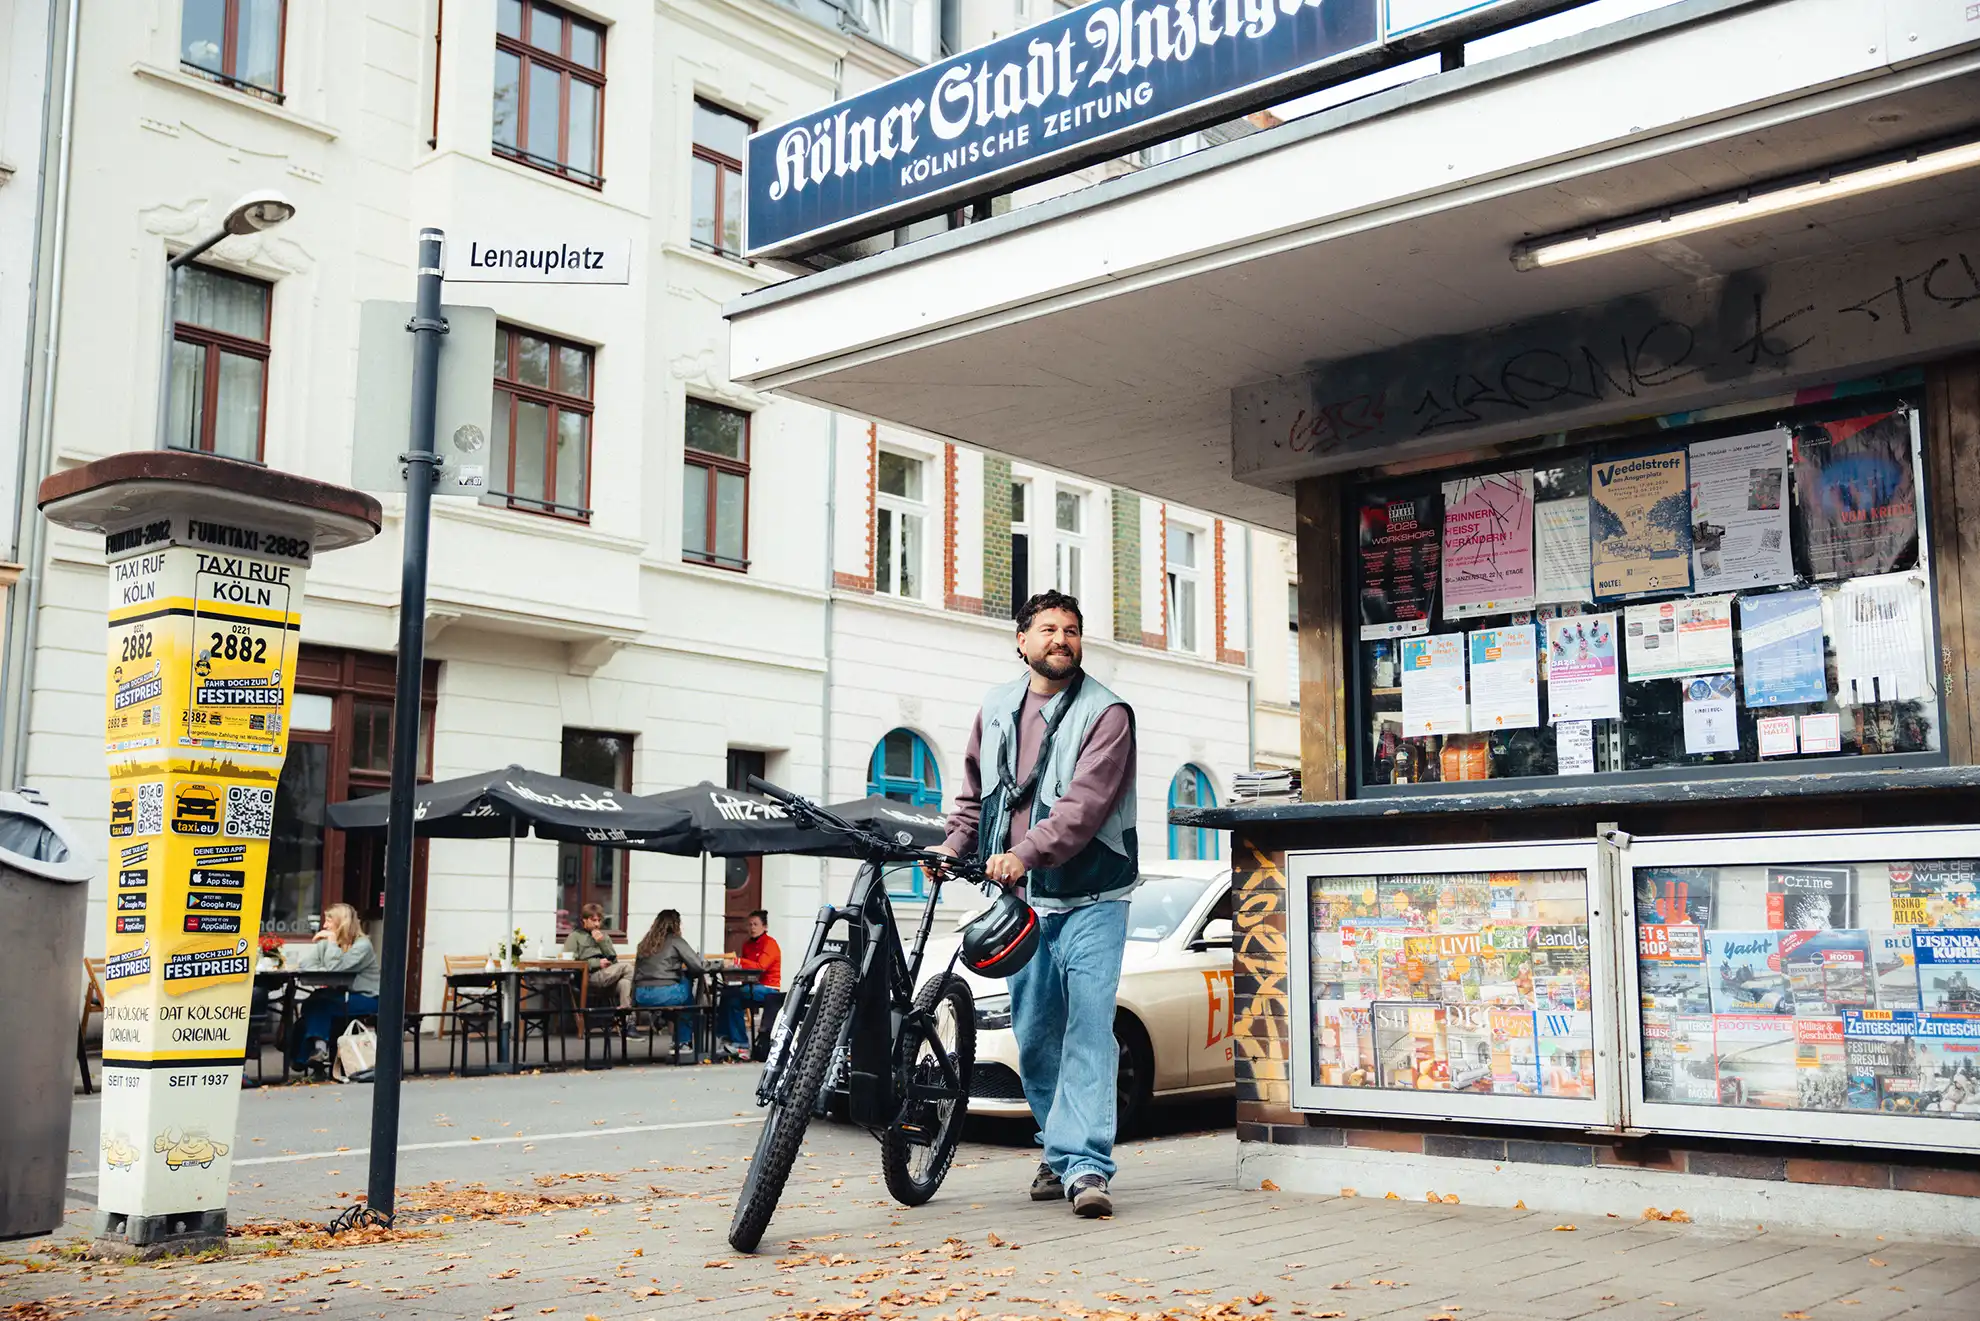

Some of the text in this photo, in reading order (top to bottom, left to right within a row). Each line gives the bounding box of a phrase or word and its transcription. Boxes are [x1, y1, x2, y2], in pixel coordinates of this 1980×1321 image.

[769, 0, 1322, 200] Kölner Stadt-Anzeig
[901, 82, 1154, 187] KÖLNISCHE ZEITUNG
[470, 242, 605, 274] Lenauplatz
[1597, 459, 1681, 487] Veedelstreff
[1445, 508, 1496, 523] ERINNERN
[1386, 521, 1418, 533] 2026
[1445, 524, 1480, 536] HEISST
[188, 519, 310, 560] FUNKTAXI-2882
[1372, 530, 1435, 545] WORKSHOPS
[116, 554, 166, 581] TAXI RUF
[197, 554, 290, 584] TAXI RUF
[1599, 580, 1618, 588] NOLTE
[123, 581, 155, 605] KÖLN
[213, 580, 271, 606] KÖLN
[232, 624, 250, 634] 0221
[122, 632, 153, 662] 2882
[210, 632, 266, 664] 2882
[228, 679, 249, 687] DOCH
[115, 680, 161, 708] FESTPREIS!
[200, 688, 282, 704] FESTPREIS!
[187, 730, 218, 738] argeldlose
[112, 825, 132, 835] taxi.eu
[177, 822, 214, 833] taxi.eu
[1914, 861, 1976, 871] welt der
[1784, 875, 1833, 889] Crime
[1914, 872, 1976, 882] wunder
[200, 901, 240, 910] Google Play
[1893, 899, 1924, 909] RISIKO-
[1894, 910, 1924, 923] ATLAS
[201, 923, 238, 931] AppGallery
[173, 949, 233, 963] FAHR DOCH ZUM
[1933, 947, 1980, 959] KURIE
[106, 958, 150, 979] FESTPREIS!
[165, 959, 248, 979] FESTPREIS!
[118, 1005, 150, 1022] KÖLSCHE
[159, 1004, 247, 1021] DAT KÖLSCHE
[1865, 1011, 1891, 1019] EXTRA
[1800, 1022, 1833, 1031] Militär &
[109, 1028, 141, 1043] ORIGINAL
[172, 1027, 231, 1042] ORIGINAL
[1800, 1031, 1842, 1041] Geschichte
[1848, 1042, 1887, 1054] FESTUNG
[1851, 1054, 1889, 1066] BRESLAU
[1855, 1067, 1875, 1077] 1945
[108, 1075, 140, 1088] SEIT 1937
[168, 1074, 229, 1087] SEIT 1937
